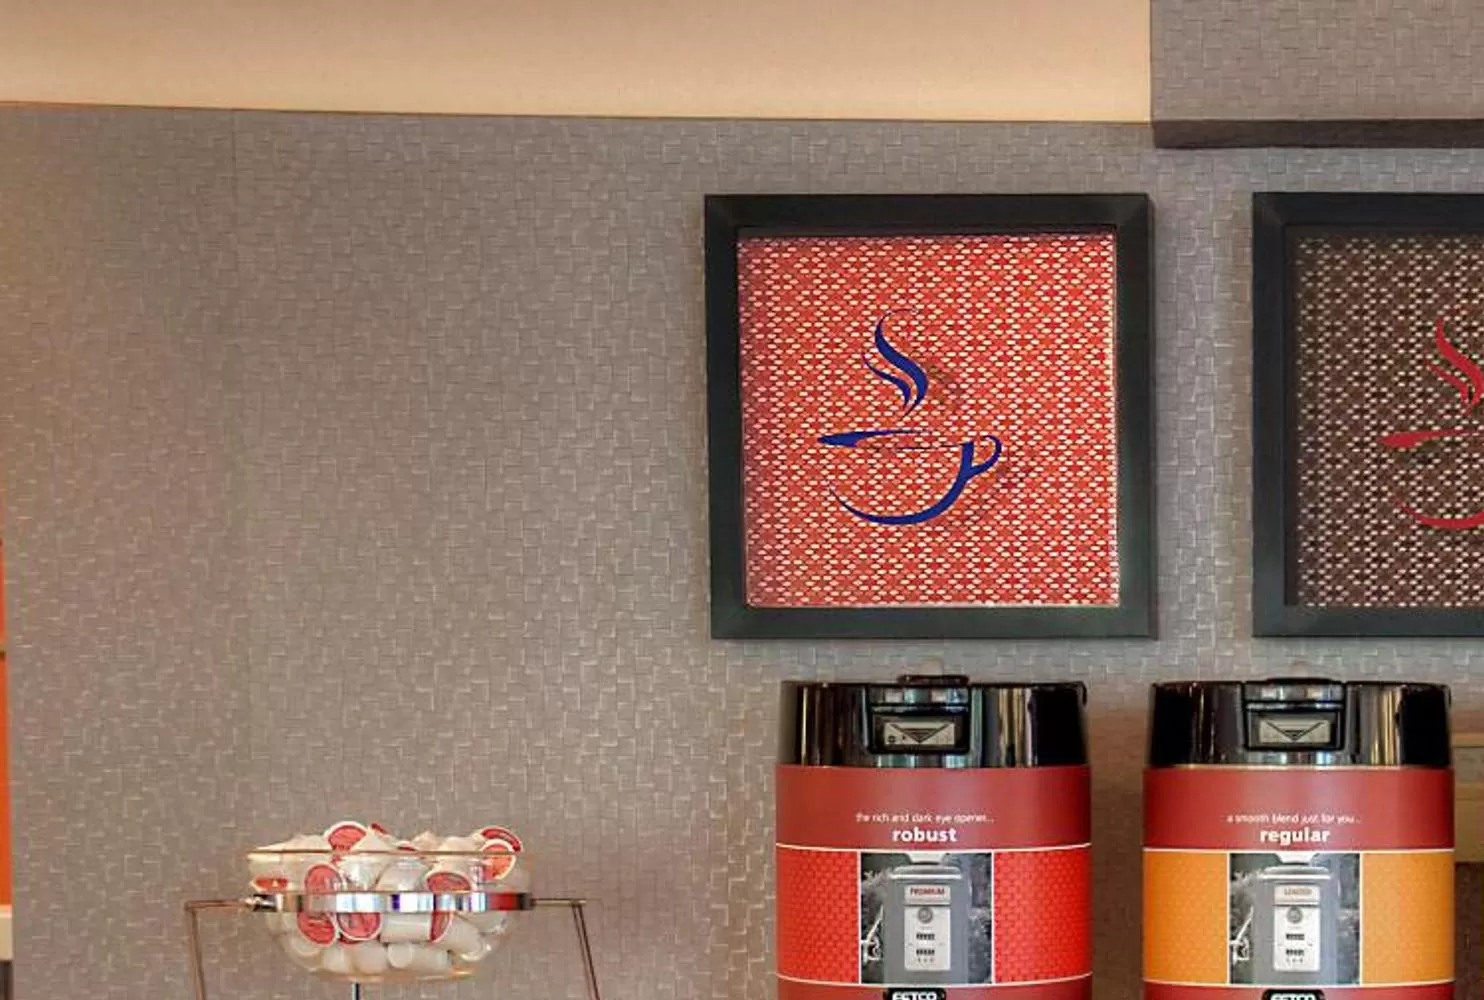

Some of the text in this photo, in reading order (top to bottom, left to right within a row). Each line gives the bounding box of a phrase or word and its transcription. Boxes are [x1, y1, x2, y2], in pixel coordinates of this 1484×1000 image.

[856, 812, 869, 822] the
[872, 812, 890, 823] rich
[891, 812, 909, 823] and
[912, 812, 932, 823] dark
[936, 814, 951, 825] eye
[1235, 813, 1269, 823] smooth
[1271, 813, 1299, 824] blend
[1300, 813, 1318, 825] just
[1321, 813, 1335, 823] for
[892, 826, 958, 842] robust
[1260, 826, 1331, 846] regular
